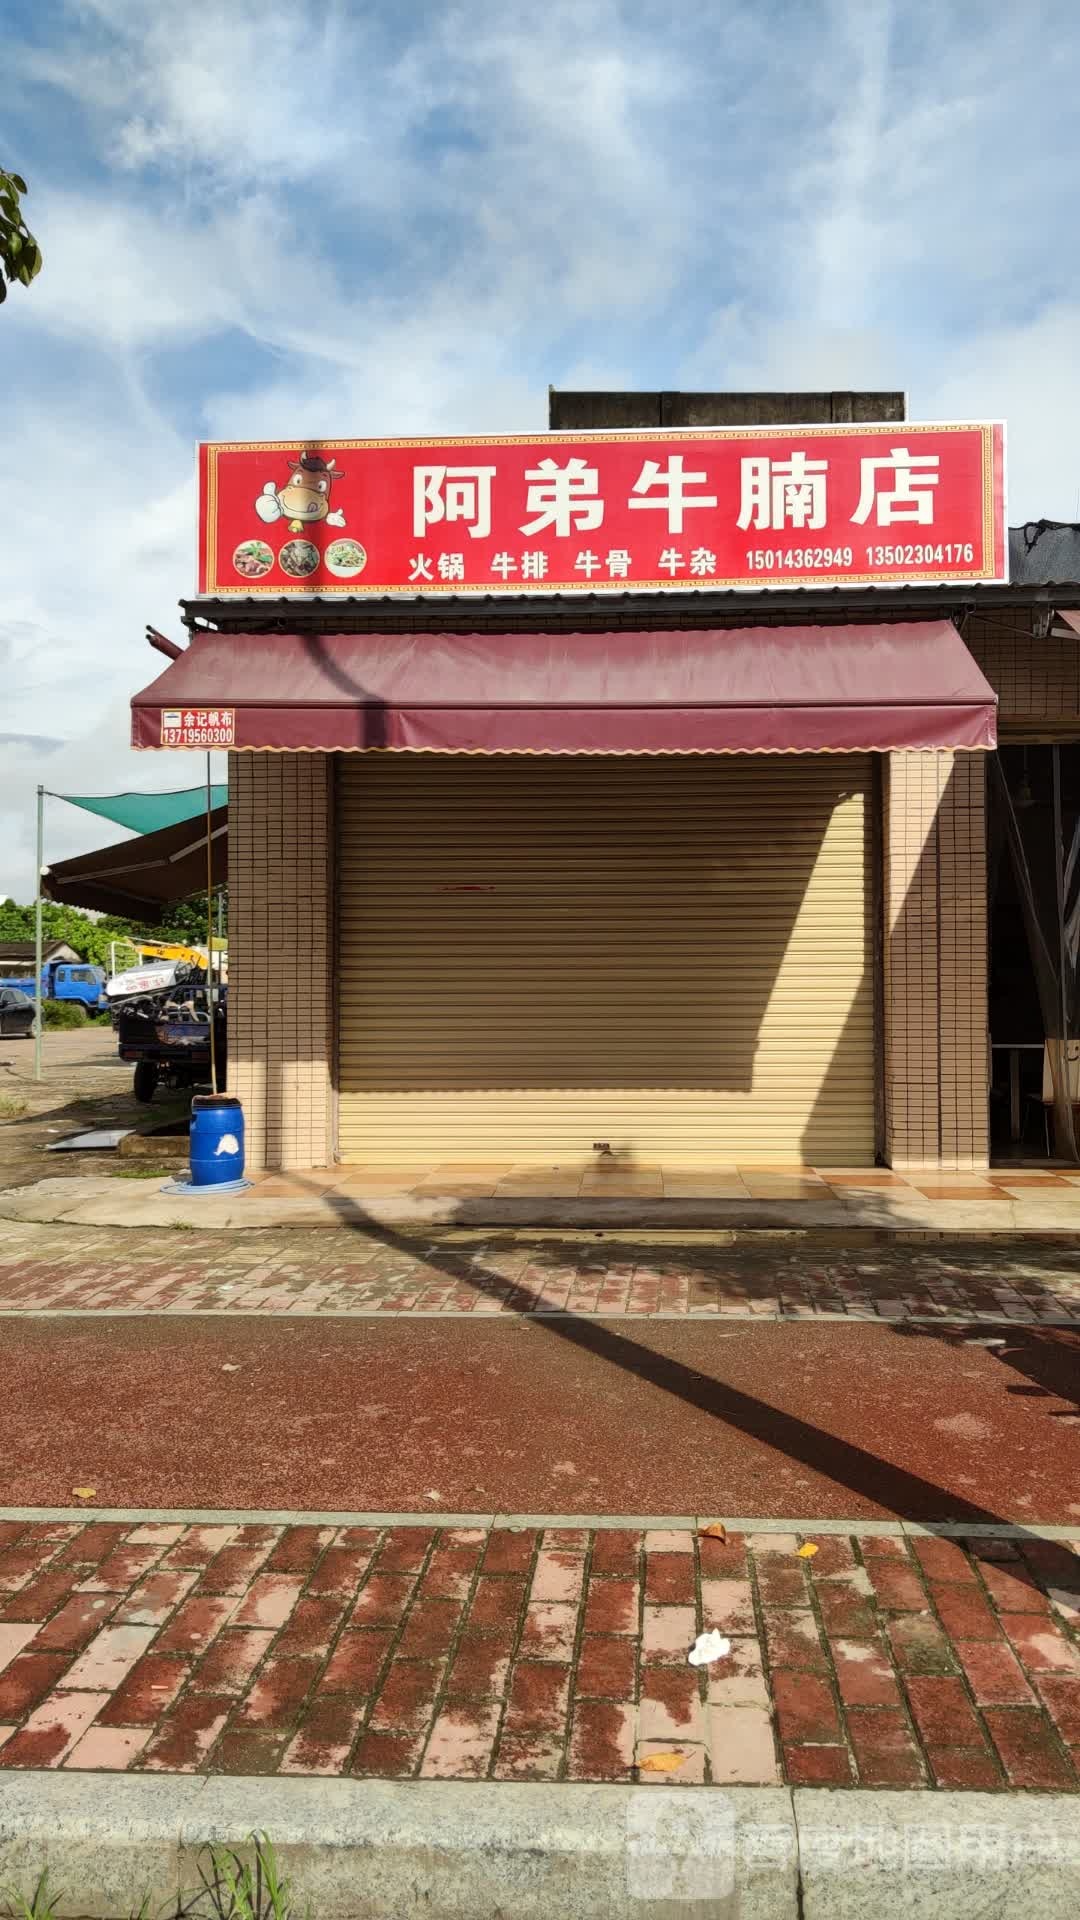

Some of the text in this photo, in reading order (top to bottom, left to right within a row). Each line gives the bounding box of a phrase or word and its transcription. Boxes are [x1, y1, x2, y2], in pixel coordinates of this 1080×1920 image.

[413, 448, 940, 538] 阿弟牛腩店
[409, 543, 974, 581] 火锅 牛排 牛骨 牛杂 15014362949 13502304176
[163, 728, 233, 743] 13719560300
